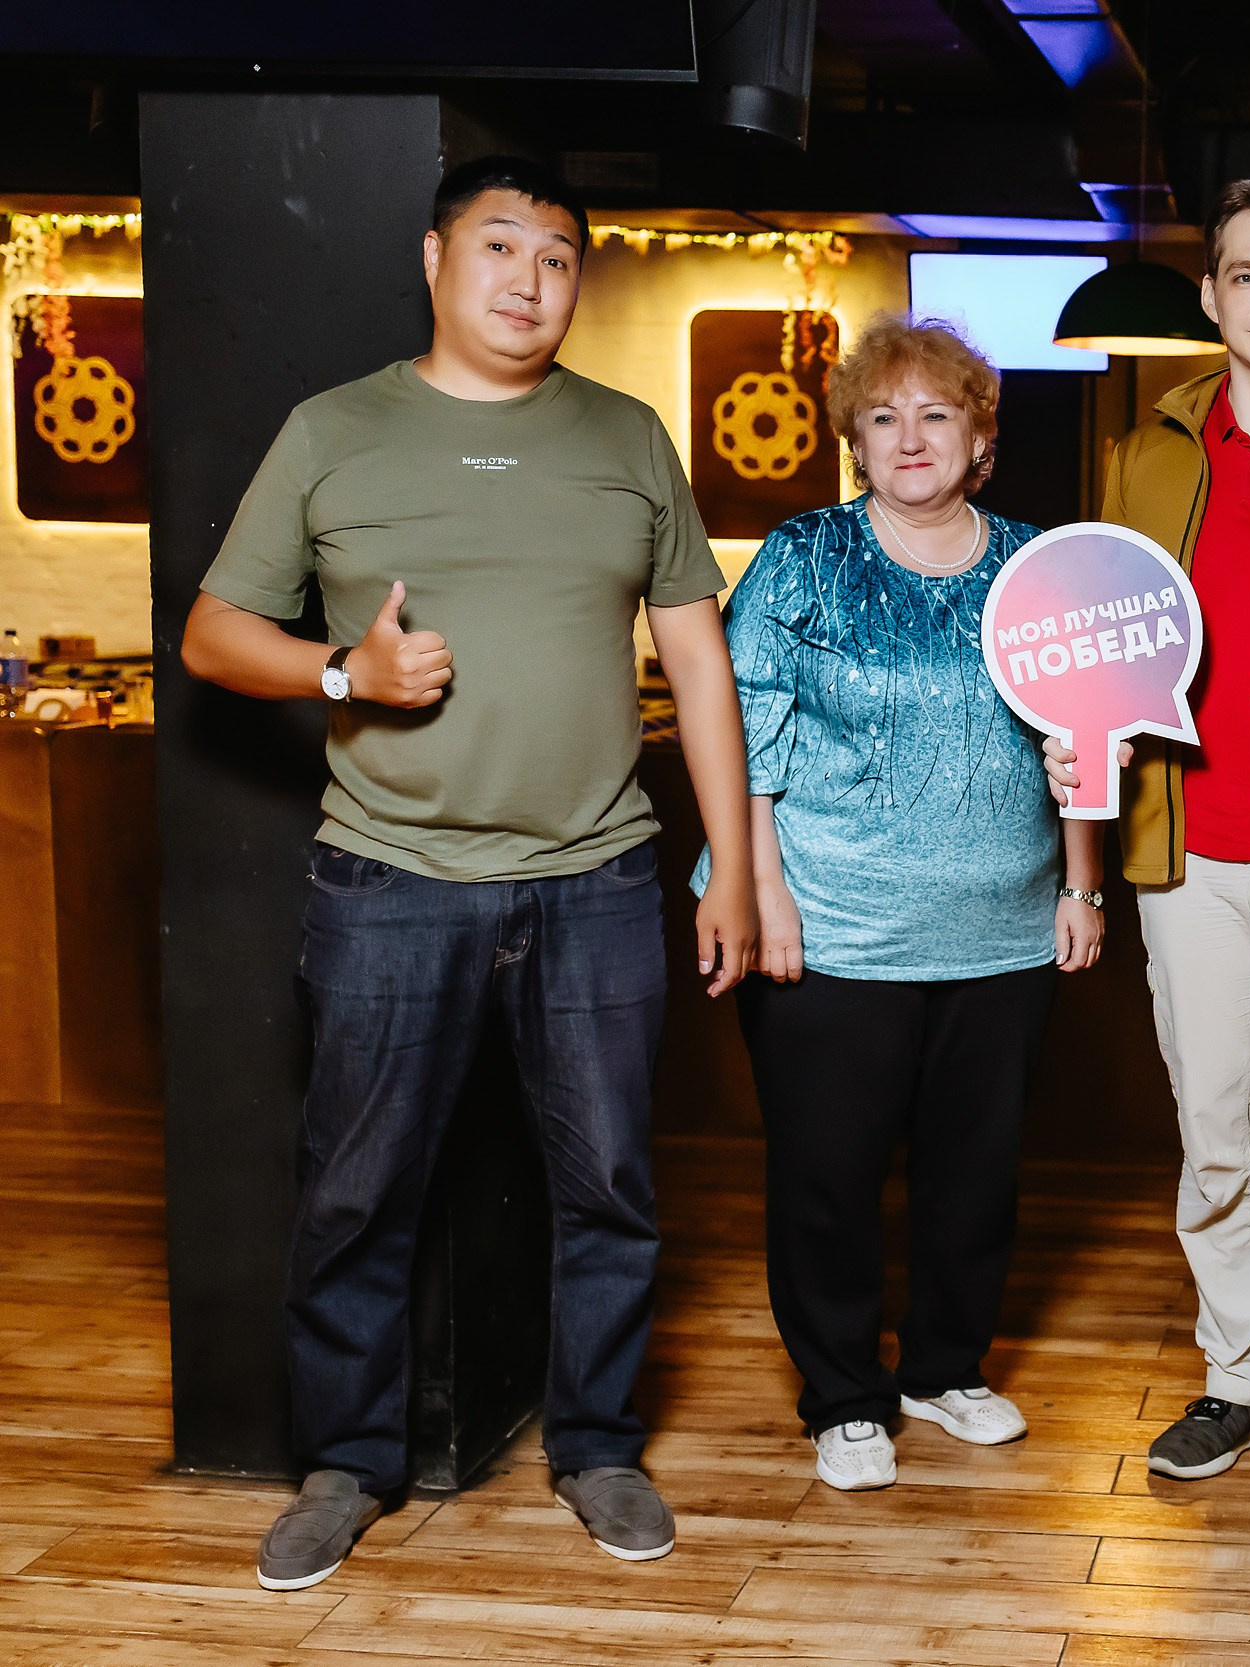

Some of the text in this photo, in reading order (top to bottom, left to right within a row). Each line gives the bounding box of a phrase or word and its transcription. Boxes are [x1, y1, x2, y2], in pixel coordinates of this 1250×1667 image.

[462, 457, 518, 465] Marc O'Polo
[996, 586, 1178, 650] МОЯ ЛУЧШАЯ
[1007, 615, 1185, 686] ПОБЕДА
